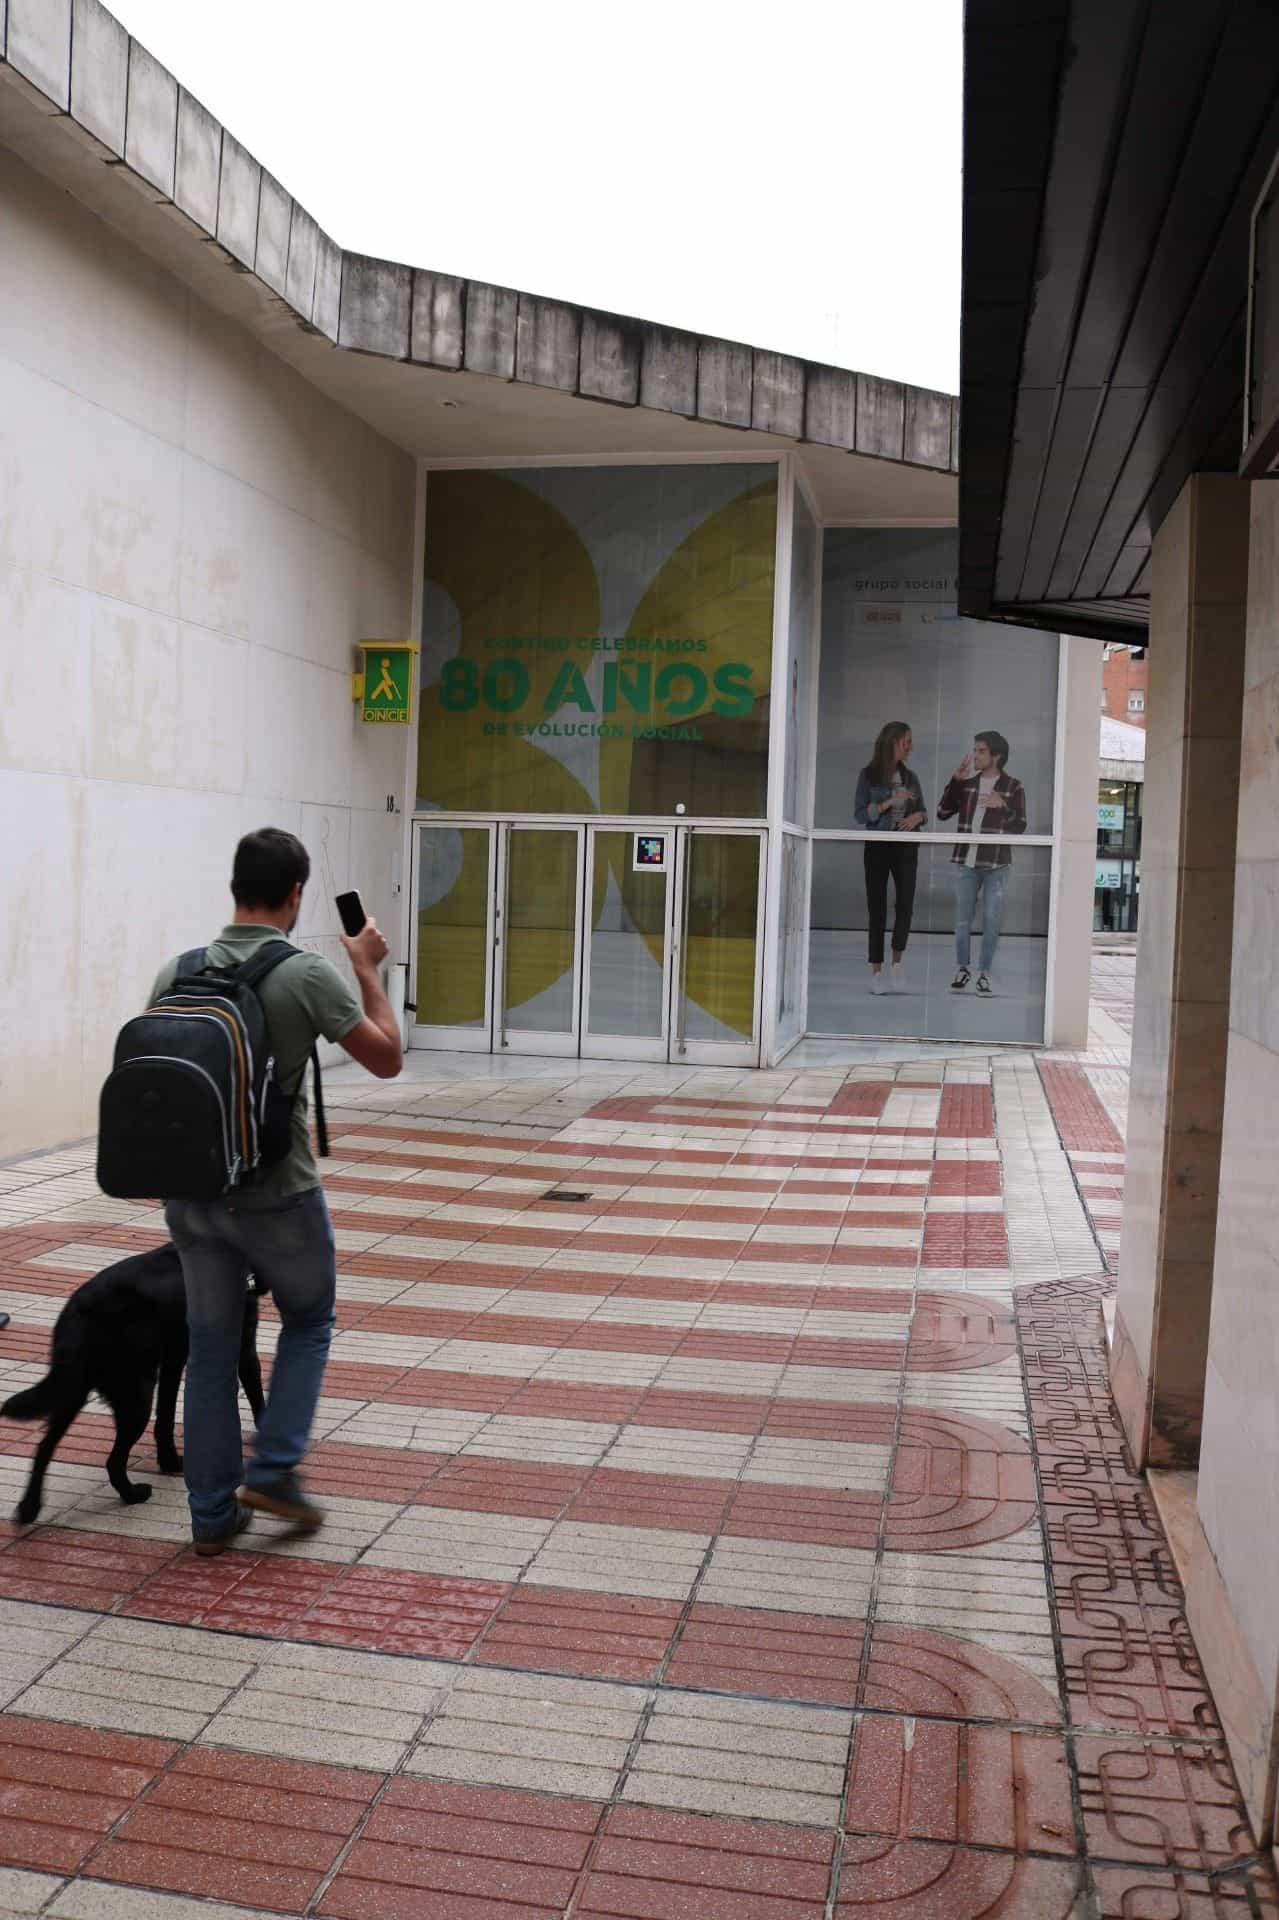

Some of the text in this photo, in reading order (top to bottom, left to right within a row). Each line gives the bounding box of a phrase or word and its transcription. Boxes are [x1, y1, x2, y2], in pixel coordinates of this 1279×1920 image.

[576, 636, 707, 653] CELEBRAMOS
[439, 656, 755, 718] 80 AÑOS
[364, 710, 409, 721] ONCE
[482, 719, 704, 742] DE EVOLUCIÓN SOCIAL
